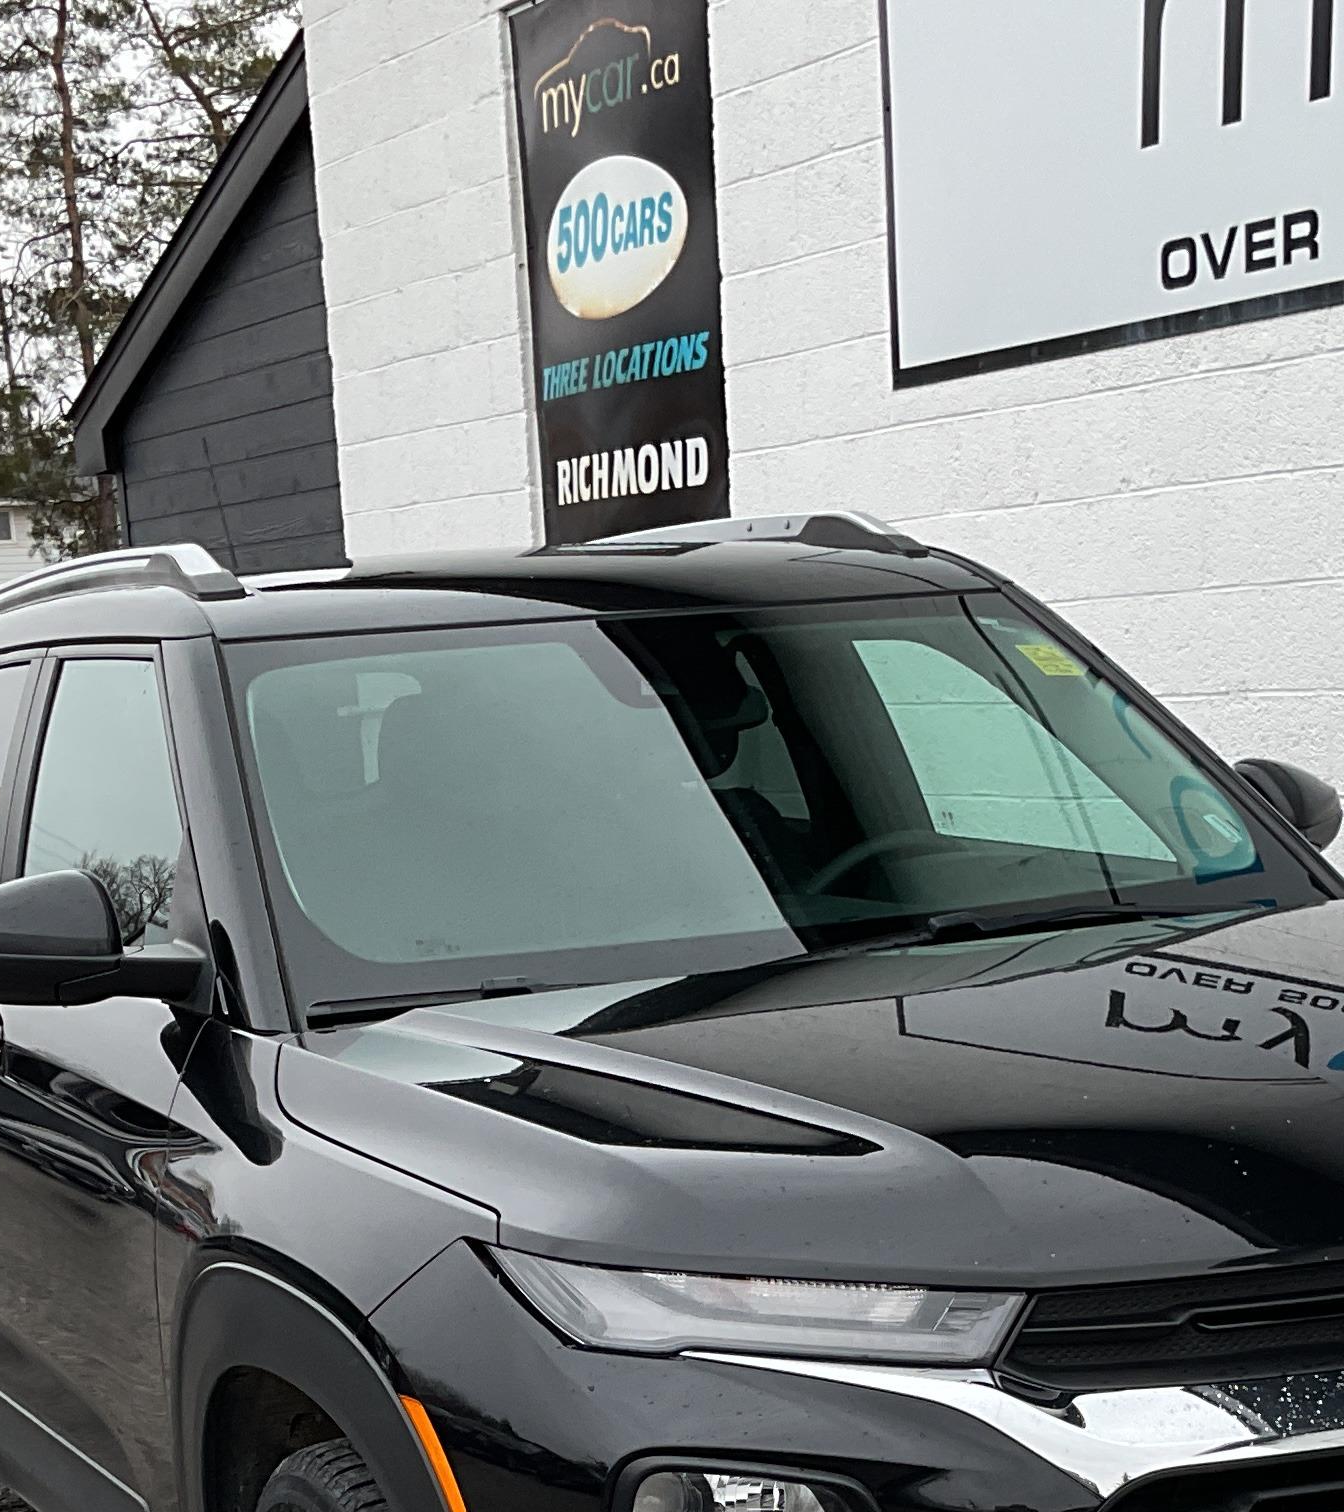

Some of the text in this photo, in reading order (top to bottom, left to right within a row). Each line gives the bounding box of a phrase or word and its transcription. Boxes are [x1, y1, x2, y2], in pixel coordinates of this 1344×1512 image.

[541, 52, 680, 138] mycar.ca
[1160, 209, 1319, 290] OVER
[543, 331, 710, 401] THREE LOCATIONS
[556, 437, 709, 506] RICHMOND
